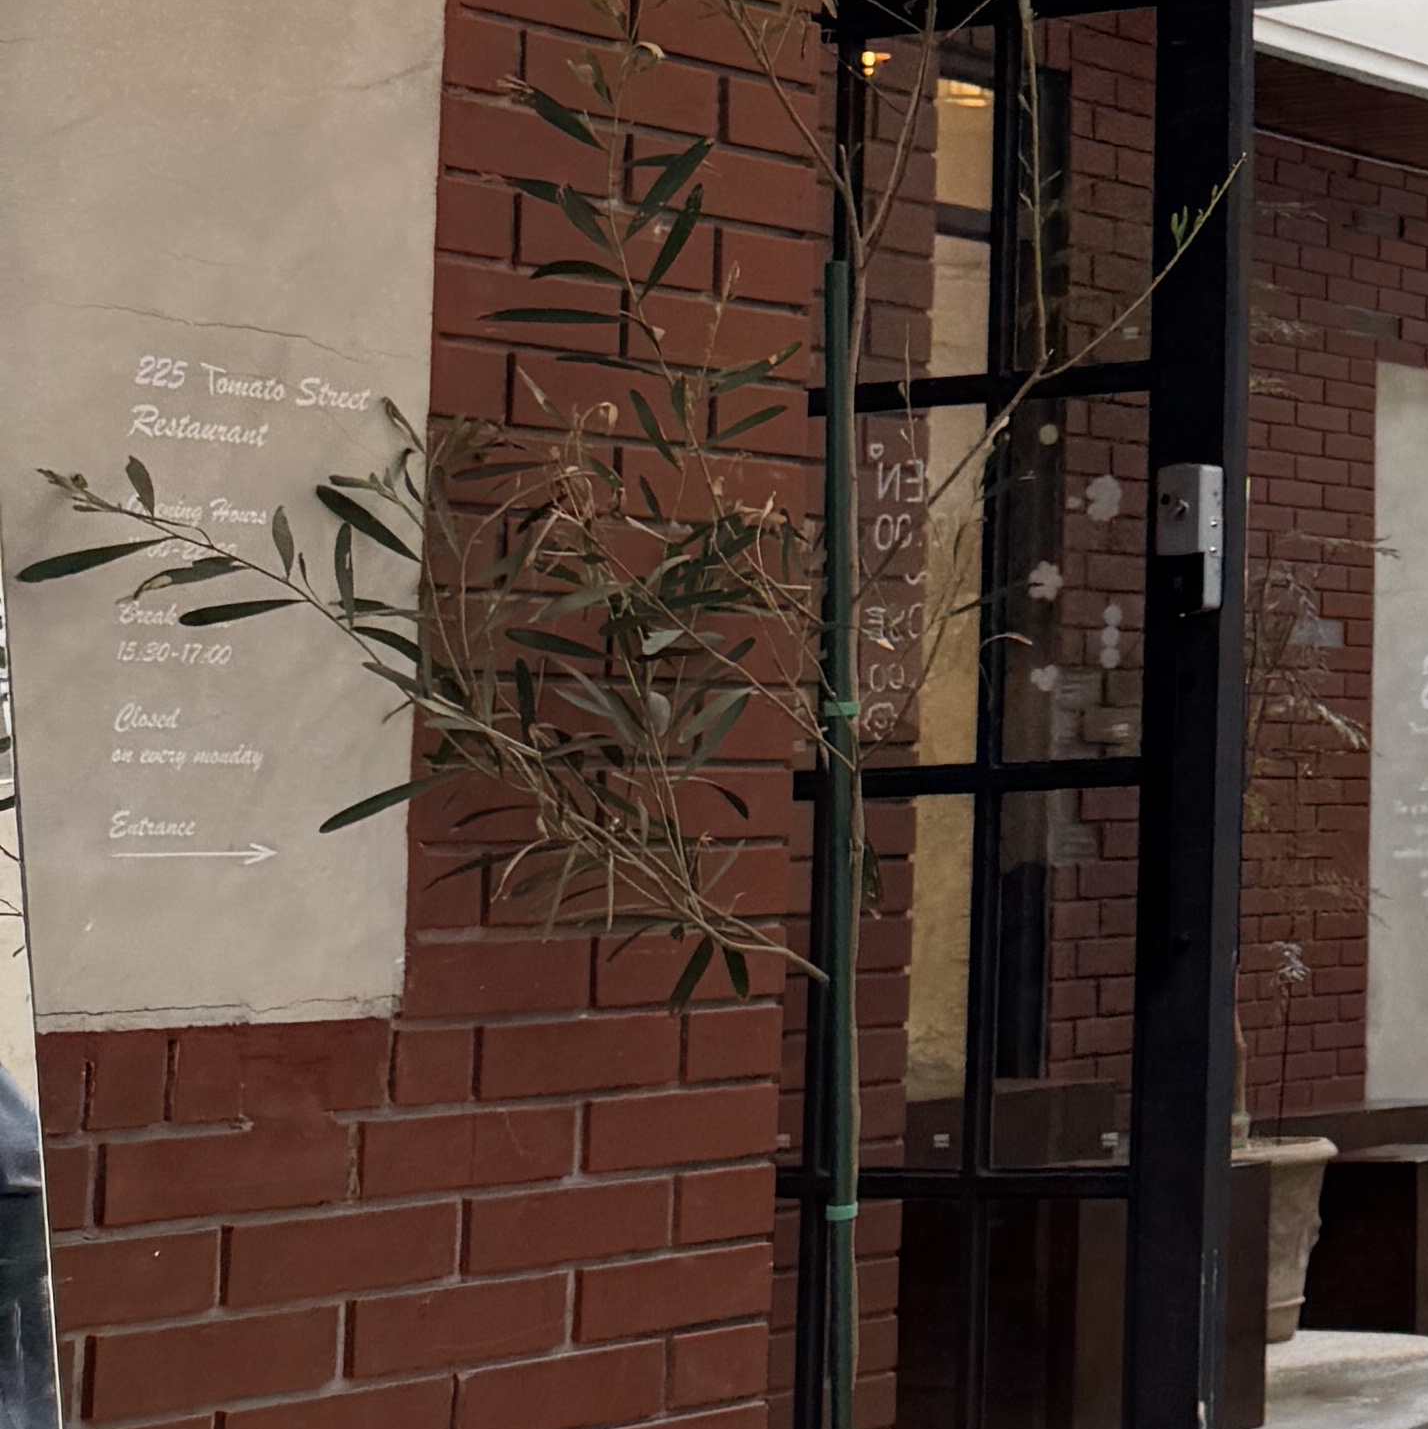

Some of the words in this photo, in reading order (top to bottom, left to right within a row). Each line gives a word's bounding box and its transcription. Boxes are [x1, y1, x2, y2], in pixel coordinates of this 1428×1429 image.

[134, 355, 189, 389] 225
[200, 362, 286, 401] Tomato
[295, 377, 371, 411] Street
[127, 403, 269, 447] Restaurant
[126, 495, 203, 528] Oening
[209, 498, 267, 525] Hours
[118, 601, 178, 626] Break
[114, 702, 181, 733] Closed
[111, 748, 134, 764] on
[140, 749, 188, 771] every
[193, 744, 264, 772] monday
[109, 810, 196, 839] Entrance
